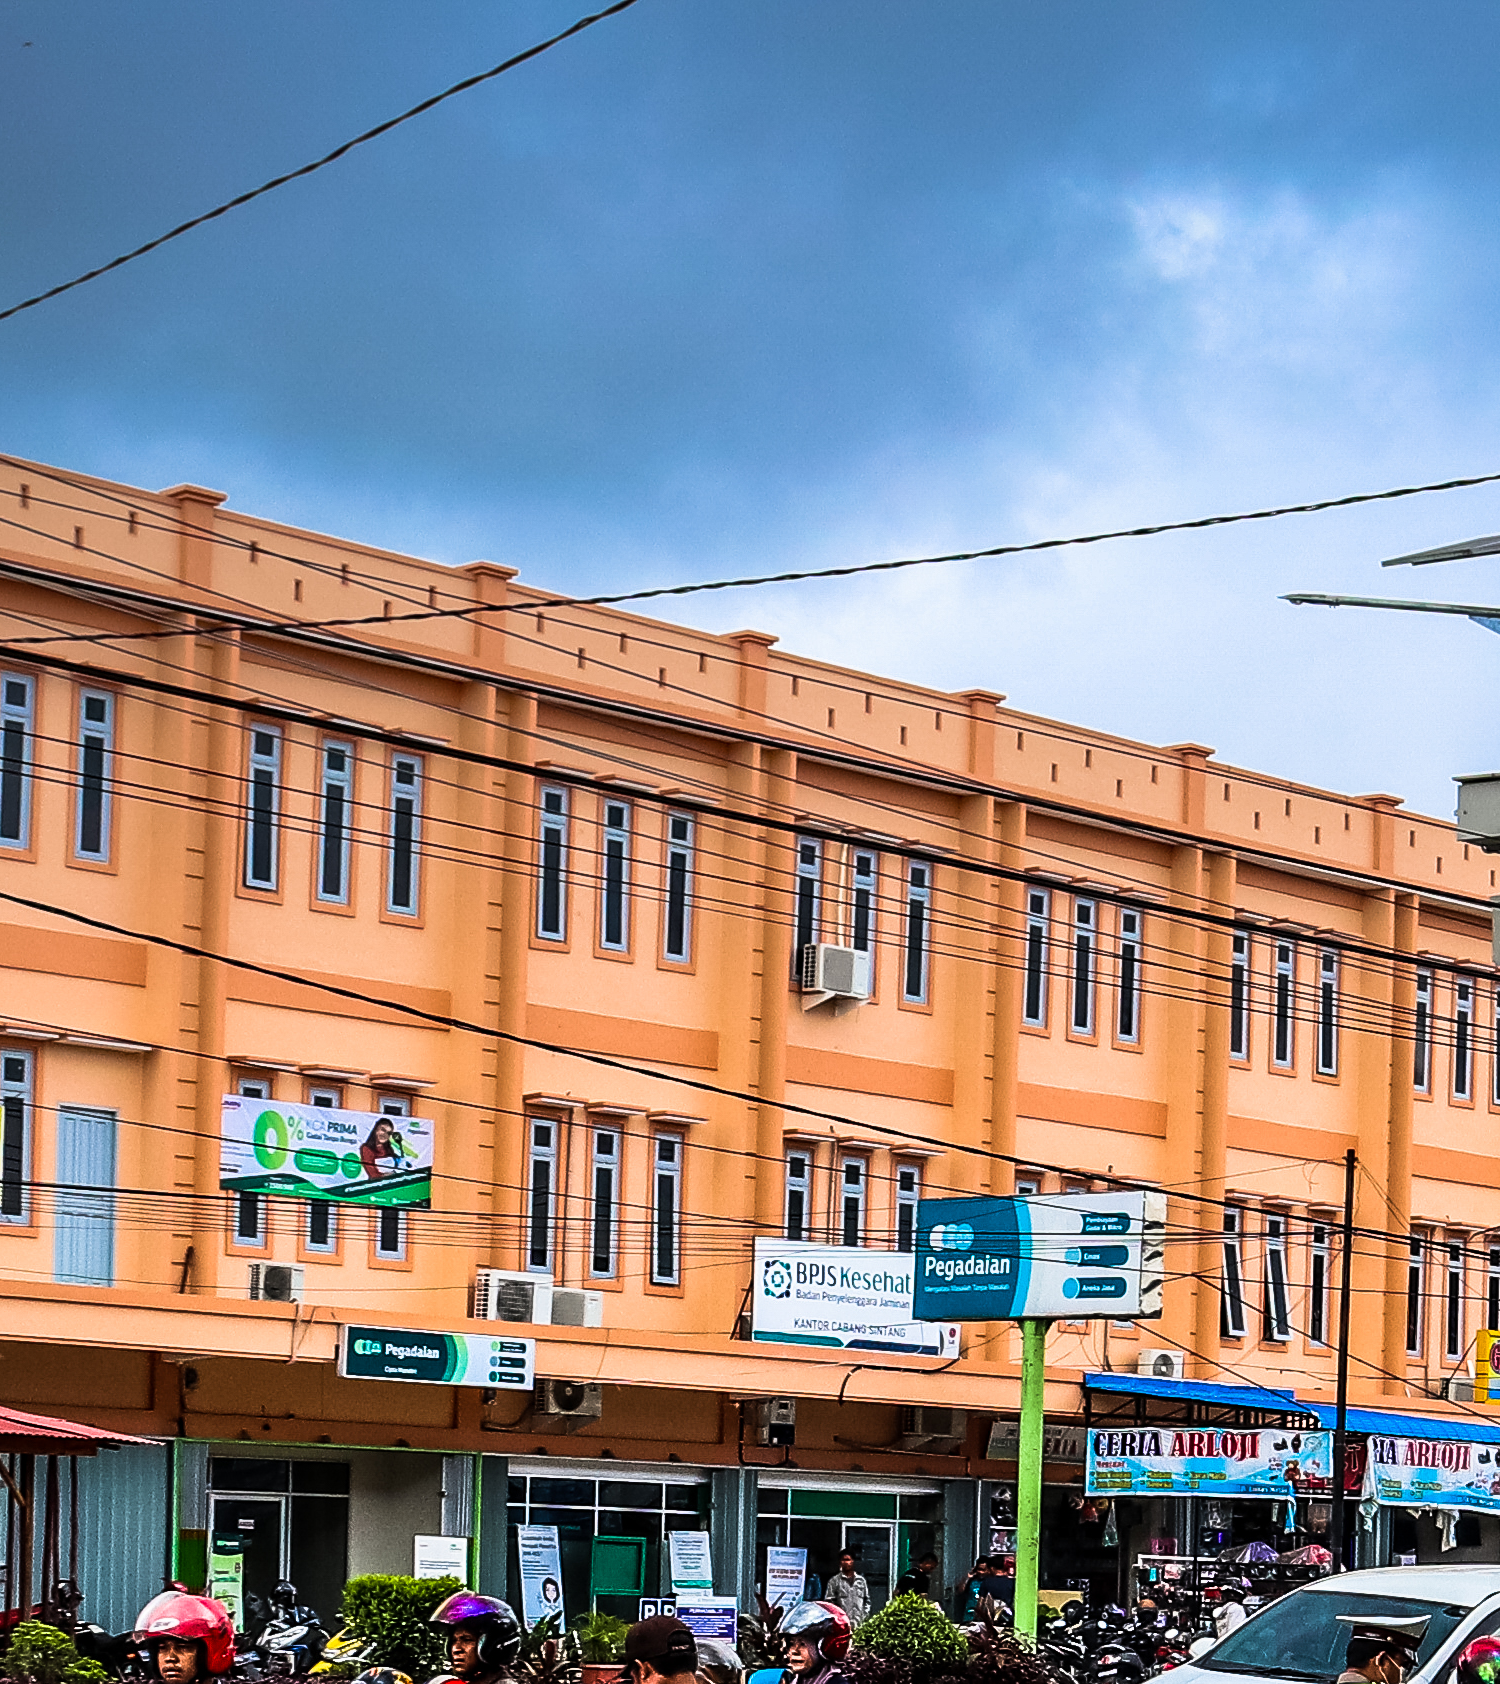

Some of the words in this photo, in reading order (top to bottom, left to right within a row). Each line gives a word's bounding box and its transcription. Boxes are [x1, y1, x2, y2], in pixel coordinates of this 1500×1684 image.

[327, 1119, 358, 1135] PRIMA
[796, 1262, 837, 1287] BPJS
[925, 1255, 1010, 1281] Pegadaian
[796, 1289, 820, 1301] Badan
[822, 1292, 877, 1309] Penyelenggara
[794, 1317, 830, 1331] KANTOR
[832, 1321, 866, 1335] CABANG
[868, 1325, 907, 1338] SINTANG
[385, 1343, 440, 1359] Pegadaian
[1094, 1432, 1163, 1457] CERIA
[1171, 1432, 1261, 1462] ARLOJI
[1404, 1440, 1471, 1472] ARLOJI
